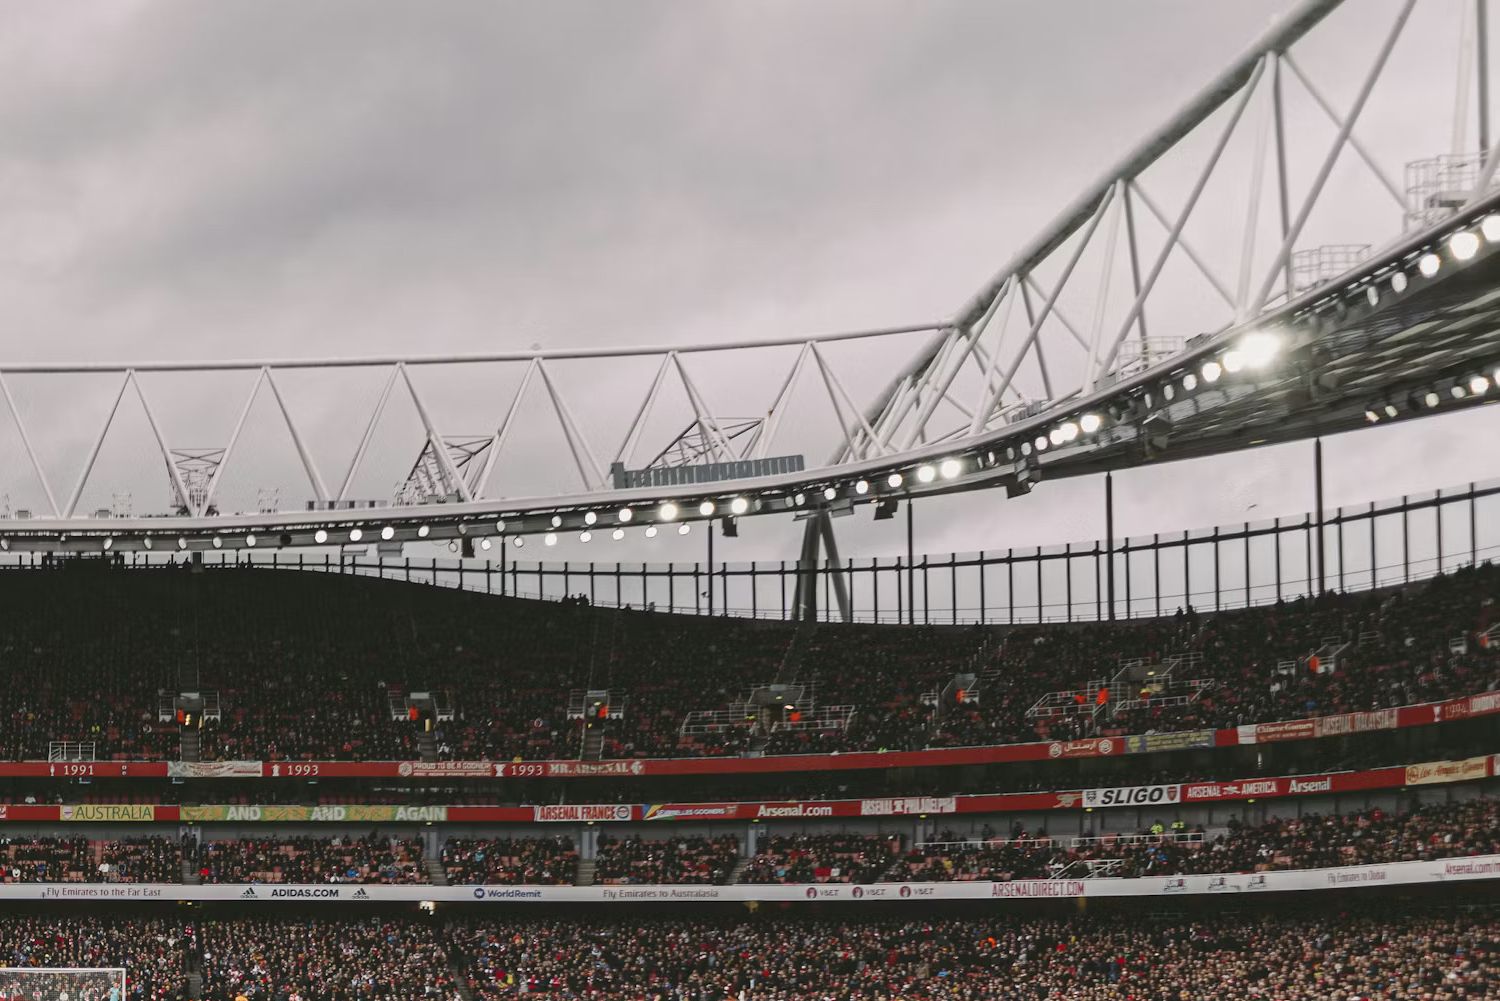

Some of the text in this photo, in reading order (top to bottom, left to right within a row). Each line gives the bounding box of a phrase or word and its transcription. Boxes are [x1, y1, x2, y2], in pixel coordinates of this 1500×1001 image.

[63, 765, 94, 776] 1991
[287, 765, 319, 776] 1993
[413, 762, 436, 770] PROUD
[437, 762, 445, 770] TO
[446, 762, 456, 770] BE
[511, 765, 543, 776] 1993
[1187, 781, 1277, 799] ARSENAL AMERICA
[1288, 776, 1331, 793] Arsenal
[1101, 787, 1164, 805] SLIGO
[75, 806, 152, 819] AUSTRALIA
[227, 807, 261, 820] AND
[311, 807, 346, 820] AND
[396, 807, 446, 820] AGAIN
[539, 806, 615, 820] ARSENAL FRANCE
[757, 804, 833, 816] Arsenal.com
[47, 888, 161, 898] Fly Emirates to the Far East
[271, 889, 339, 897] ADIDAS.COM
[488, 889, 541, 898] WorldRemit
[993, 881, 1085, 897] ARSENALDIRECT.COM
[603, 890, 719, 900] Fly Emirates to Australasia
